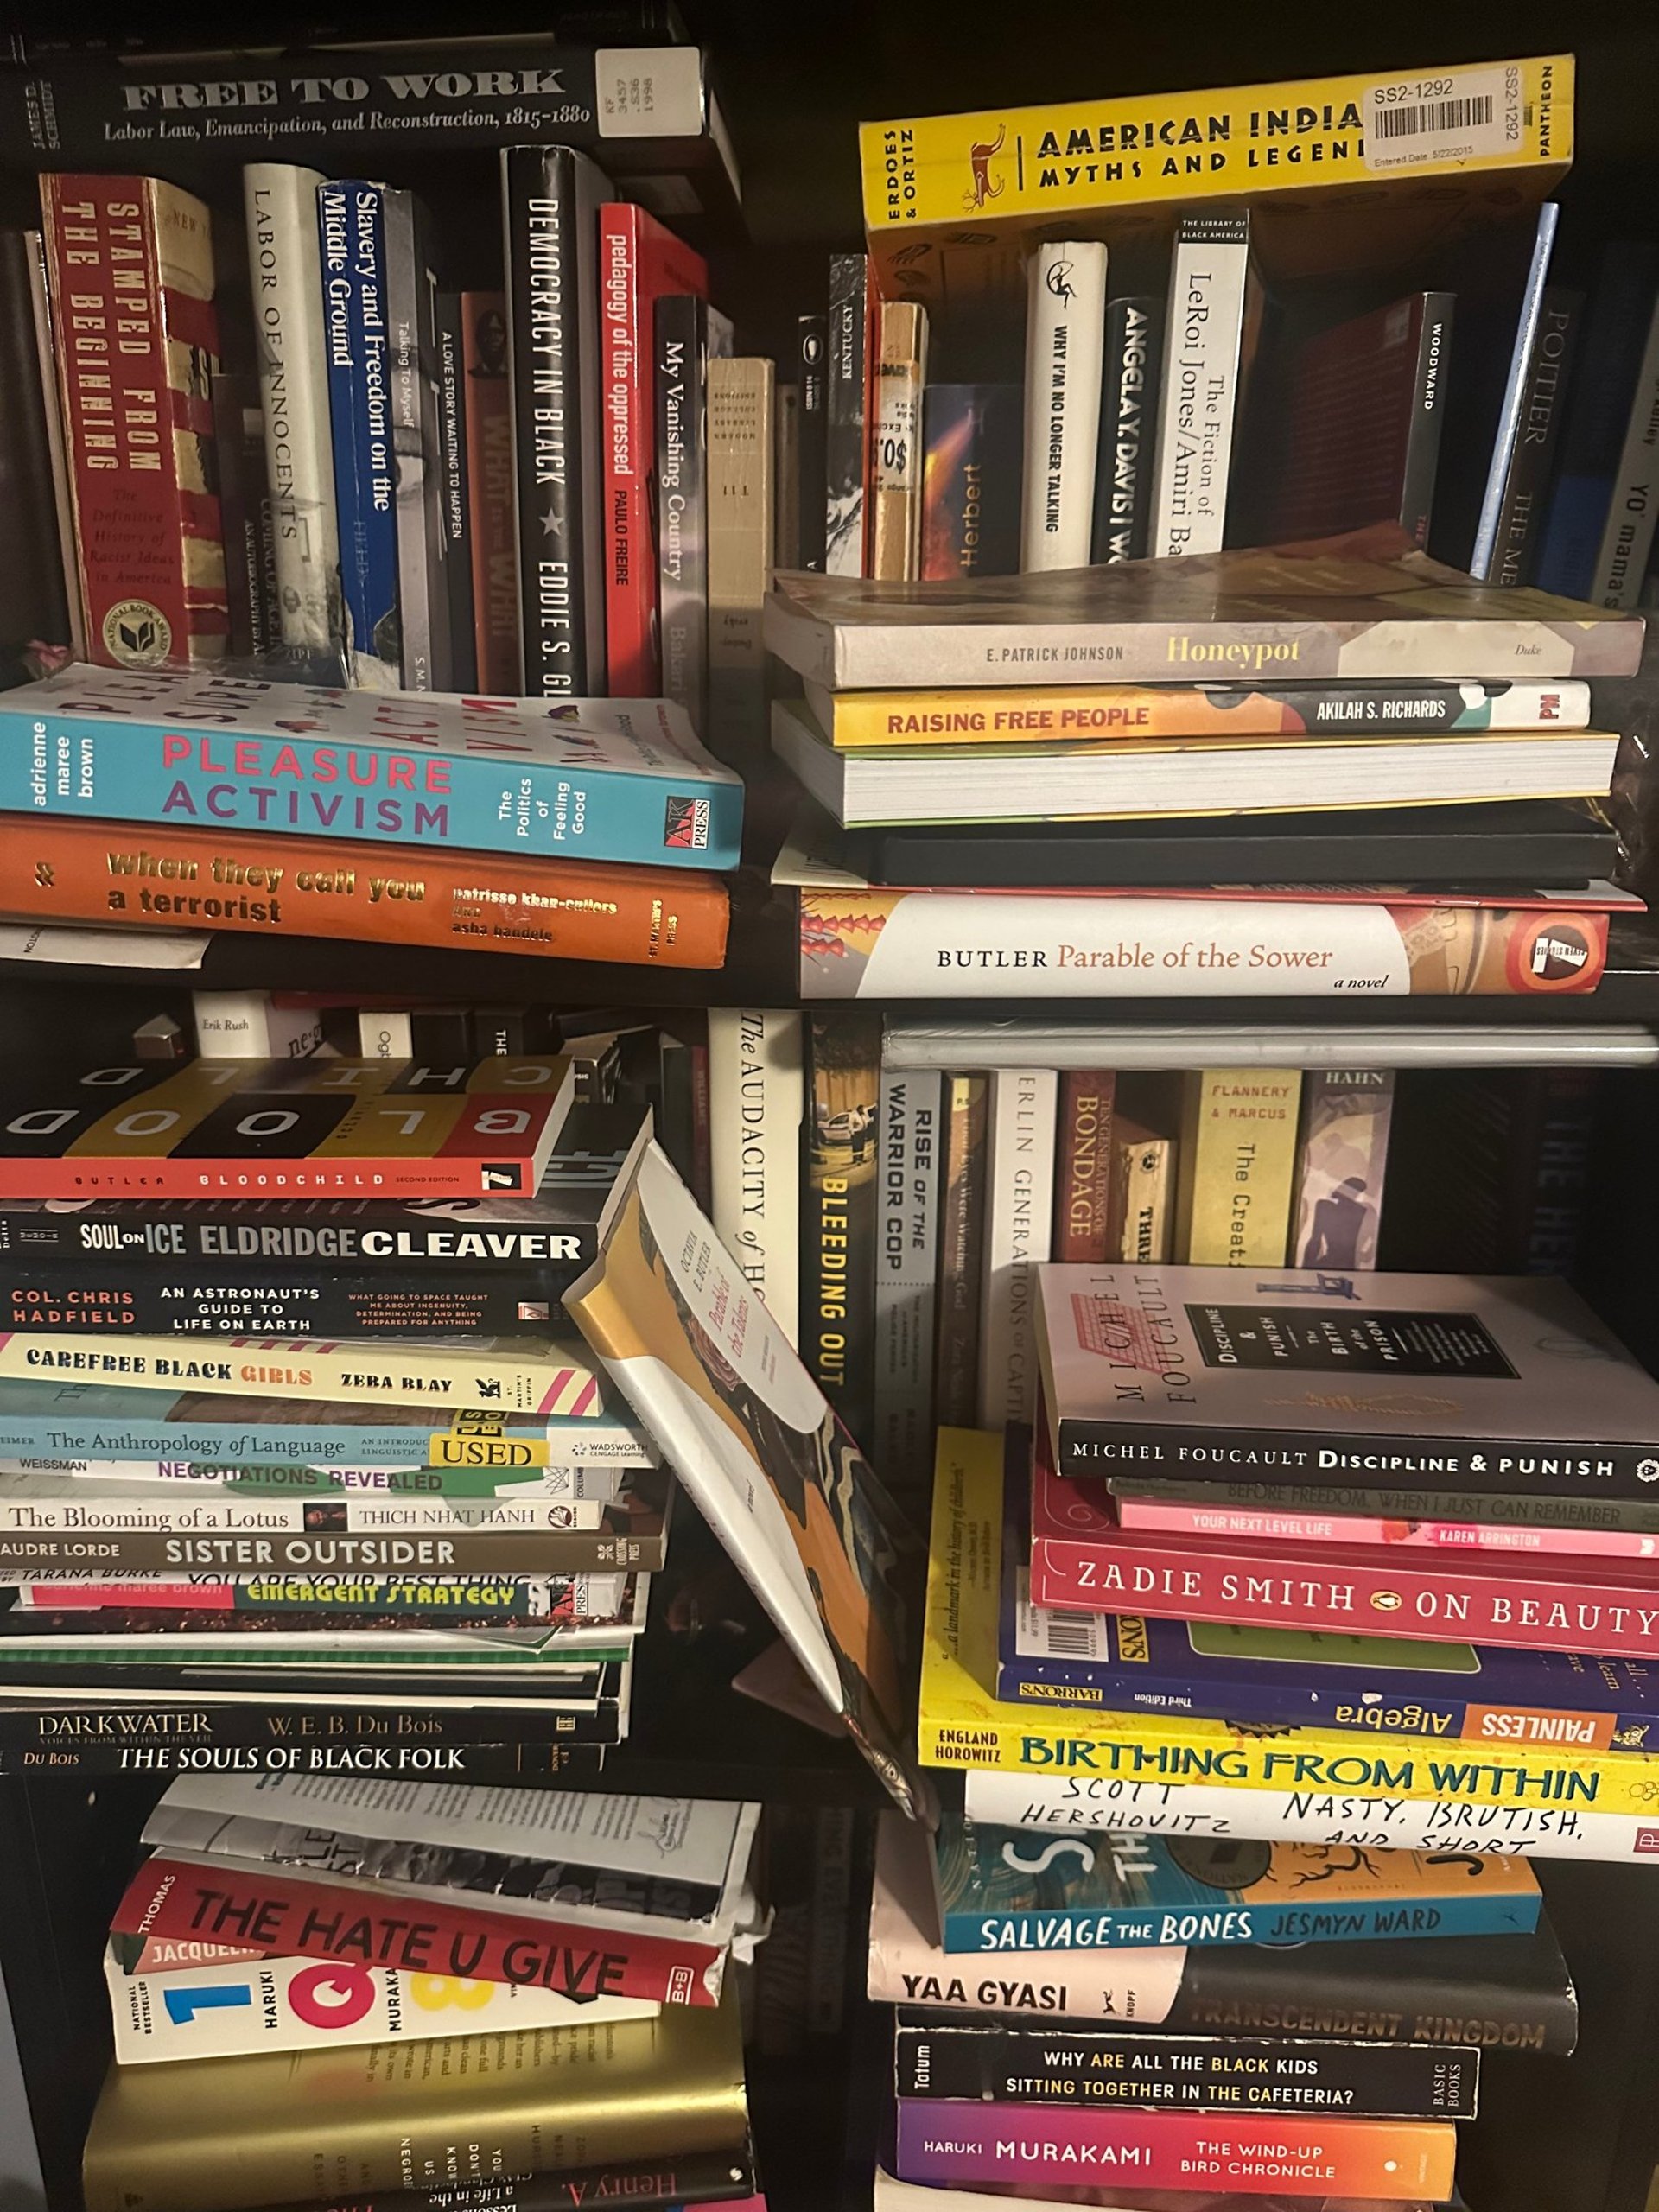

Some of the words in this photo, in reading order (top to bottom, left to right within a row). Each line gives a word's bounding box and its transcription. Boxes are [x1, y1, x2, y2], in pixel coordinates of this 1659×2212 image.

[124, 80, 278, 111] FREE
[292, 76, 369, 103] TO
[383, 69, 566, 100] WORK
[1374, 79, 1453, 105] SS2-1292
[105, 123, 154, 140] Labor
[160, 121, 200, 141] Law,
[206, 118, 327, 140] Emancipation,
[332, 111, 365, 130] and
[371, 108, 499, 130] Reconstruction,
[1539, 66, 1553, 156] PANTHEON
[1037, 115, 1230, 158] AMERICAN
[1039, 162, 1141, 188] MYTHS
[1162, 153, 1225, 175] AND
[62, 203, 100, 265] THE
[108, 202, 150, 355] STAMPED
[442, 333, 450, 343] A
[842, 304, 854, 380] KENTUCKY
[1053, 325, 1068, 359] WHY
[442, 346, 453, 372] LOVE
[1423, 322, 1443, 411] WOODWARD
[70, 294, 119, 471] BEGINNING
[1052, 363, 1066, 388] I'M
[444, 376, 456, 416] STORY
[1052, 391, 1065, 411] NO
[124, 388, 162, 471] FROM
[447, 416, 460, 471] WAITING
[1049, 416, 1064, 470] LONGER
[449, 473, 460, 490] TO
[450, 492, 463, 539] HAPPEN
[614, 490, 628, 534] PAULO
[1046, 473, 1061, 534] TALKING
[615, 538, 629, 586] FREIRE
[987, 648, 999, 663] E.
[1002, 646, 1058, 663] PATRICK
[1065, 645, 1123, 661] JOHNSON
[1167, 636, 1300, 670] Honeypot
[888, 712, 986, 734] RAISING
[995, 710, 1053, 729] FREE
[1061, 707, 1151, 728] PEOPLE
[1317, 702, 1363, 721] AKILAH
[1366, 702, 1379, 719] S.
[1382, 699, 1446, 719] RICHARDS
[30, 721, 47, 807] adrienne
[57, 736, 70, 796] maree
[78, 738, 94, 798] brown
[162, 734, 452, 794] PLEASURE
[162, 780, 448, 837] ACTIVISM
[499, 790, 512, 820] The
[517, 778, 532, 836] Politics
[538, 800, 550, 818] of
[554, 781, 571, 841] Feeling
[572, 791, 587, 835] Good
[937, 950, 1048, 968] BUTLER
[1057, 942, 1155, 968] Parable
[1163, 943, 1193, 968] of
[1198, 942, 1241, 968] the
[1249, 944, 1333, 969] Sower
[1333, 979, 1344, 989] a
[1347, 975, 1388, 989] novel
[202, 1019, 222, 1031] Erik
[224, 1019, 250, 1032] Rush
[1211, 1084, 1292, 1098] FLANNERY
[1211, 1109, 1220, 1118] &
[1229, 1108, 1287, 1120] MARCUS
[200, 1175, 383, 1185] BLOODCHILD
[360, 1231, 582, 1260] CLEAVER
[820, 1177, 848, 1319] BLEEDING
[161, 1287, 186, 1299] AN
[193, 1287, 320, 1300] ASTRONAUT'S
[198, 1303, 252, 1315] GUIDE
[260, 1304, 283, 1315] TO
[173, 1319, 214, 1330] LIFE
[220, 1319, 244, 1331] ON
[252, 1319, 310, 1331] EARTH
[27, 1348, 146, 1374] CAREFREE
[156, 1358, 232, 1381] BLACK
[240, 1365, 313, 1386] GIRLS
[819, 1334, 846, 1386] OUT
[47, 1432, 86, 1450] The
[92, 1433, 222, 1456] Anthropology
[229, 1433, 250, 1452] of
[251, 1436, 346, 1459] Language
[442, 1440, 532, 1466] USED
[589, 1443, 649, 1452] WADSWORTH
[1072, 1443, 1164, 1460] MICHEL
[1179, 1447, 1307, 1465] FOUCAULT
[1470, 1454, 1487, 1472] &
[1499, 1459, 1613, 1477] PUNISH
[9, 1507, 55, 1528] The
[63, 1508, 172, 1532] Blooming
[178, 1507, 205, 1528] of
[207, 1514, 216, 1528] a
[226, 1509, 289, 1529] Lotus
[1192, 1514, 1228, 1530] YOUR
[1230, 1516, 1263, 1532] NEXT
[1265, 1518, 1303, 1534] LEVEL
[1306, 1521, 1332, 1536] LIFE
[165, 1540, 275, 1564] SISTER
[285, 1541, 454, 1565] OUTSIDER
[1440, 1529, 1475, 1545] KAREN
[1478, 1531, 1541, 1548] ARRINGTON
[1077, 1560, 1202, 1598] ZADIE
[1220, 1574, 1355, 1611] SMITH
[1416, 1592, 1471, 1620] ON
[1491, 1597, 1659, 1636] BEAUTY
[1335, 1705, 1452, 1735] Algebra
[1481, 1713, 1596, 1743] PAINLESS
[939, 1728, 998, 1746] ENGLAND
[117, 1747, 171, 1769] THE
[178, 1747, 258, 1769] SOULS
[266, 1747, 301, 1769] OF
[309, 1747, 392, 1770] BLACK
[398, 1747, 467, 1770] FOLK
[935, 1745, 1001, 1764] HOROWITZ
[1019, 1736, 1249, 1779] BIRTHING
[1262, 1751, 1414, 1789] FROM
[1428, 1761, 1599, 1802] WITHIN
[981, 1916, 1114, 1950] SALVAGE
[1117, 1923, 1154, 1940] THE
[1160, 1911, 1253, 1945] BONES
[132, 1985, 142, 2031] NATIONAL
[138, 1980, 153, 2035] BESTSELLER
[901, 1974, 968, 2003] YAA
[977, 1980, 1067, 2012] GYASI
[1126, 1989, 1136, 2018] KNOPF
[913, 2044, 931, 2090] Tatum
[1044, 2051, 1085, 2067] WHY
[1090, 2052, 1125, 2068] ARE
[1132, 2054, 1163, 2070] ALL
[1170, 2056, 1204, 2071] THE
[1211, 2057, 1269, 2074] BLACK
[1276, 2059, 1319, 2075] KIDS
[1006, 2077, 1076, 2094] SITTING
[1083, 2080, 1175, 2098] TOGETHER
[1182, 2084, 1200, 2100] IN
[1208, 2085, 1241, 2101] THE
[1248, 2087, 1354, 2106] CAFETERIA?
[924, 2140, 983, 2155] HARUKI
[995, 2140, 1152, 2167] MURAKAMI
[1196, 2140, 1231, 2157] THE
[1238, 2142, 1324, 2160] WIND-UP
[1180, 2159, 1221, 2174] BIRD
[1228, 2161, 1336, 2179] CHRONICLE
